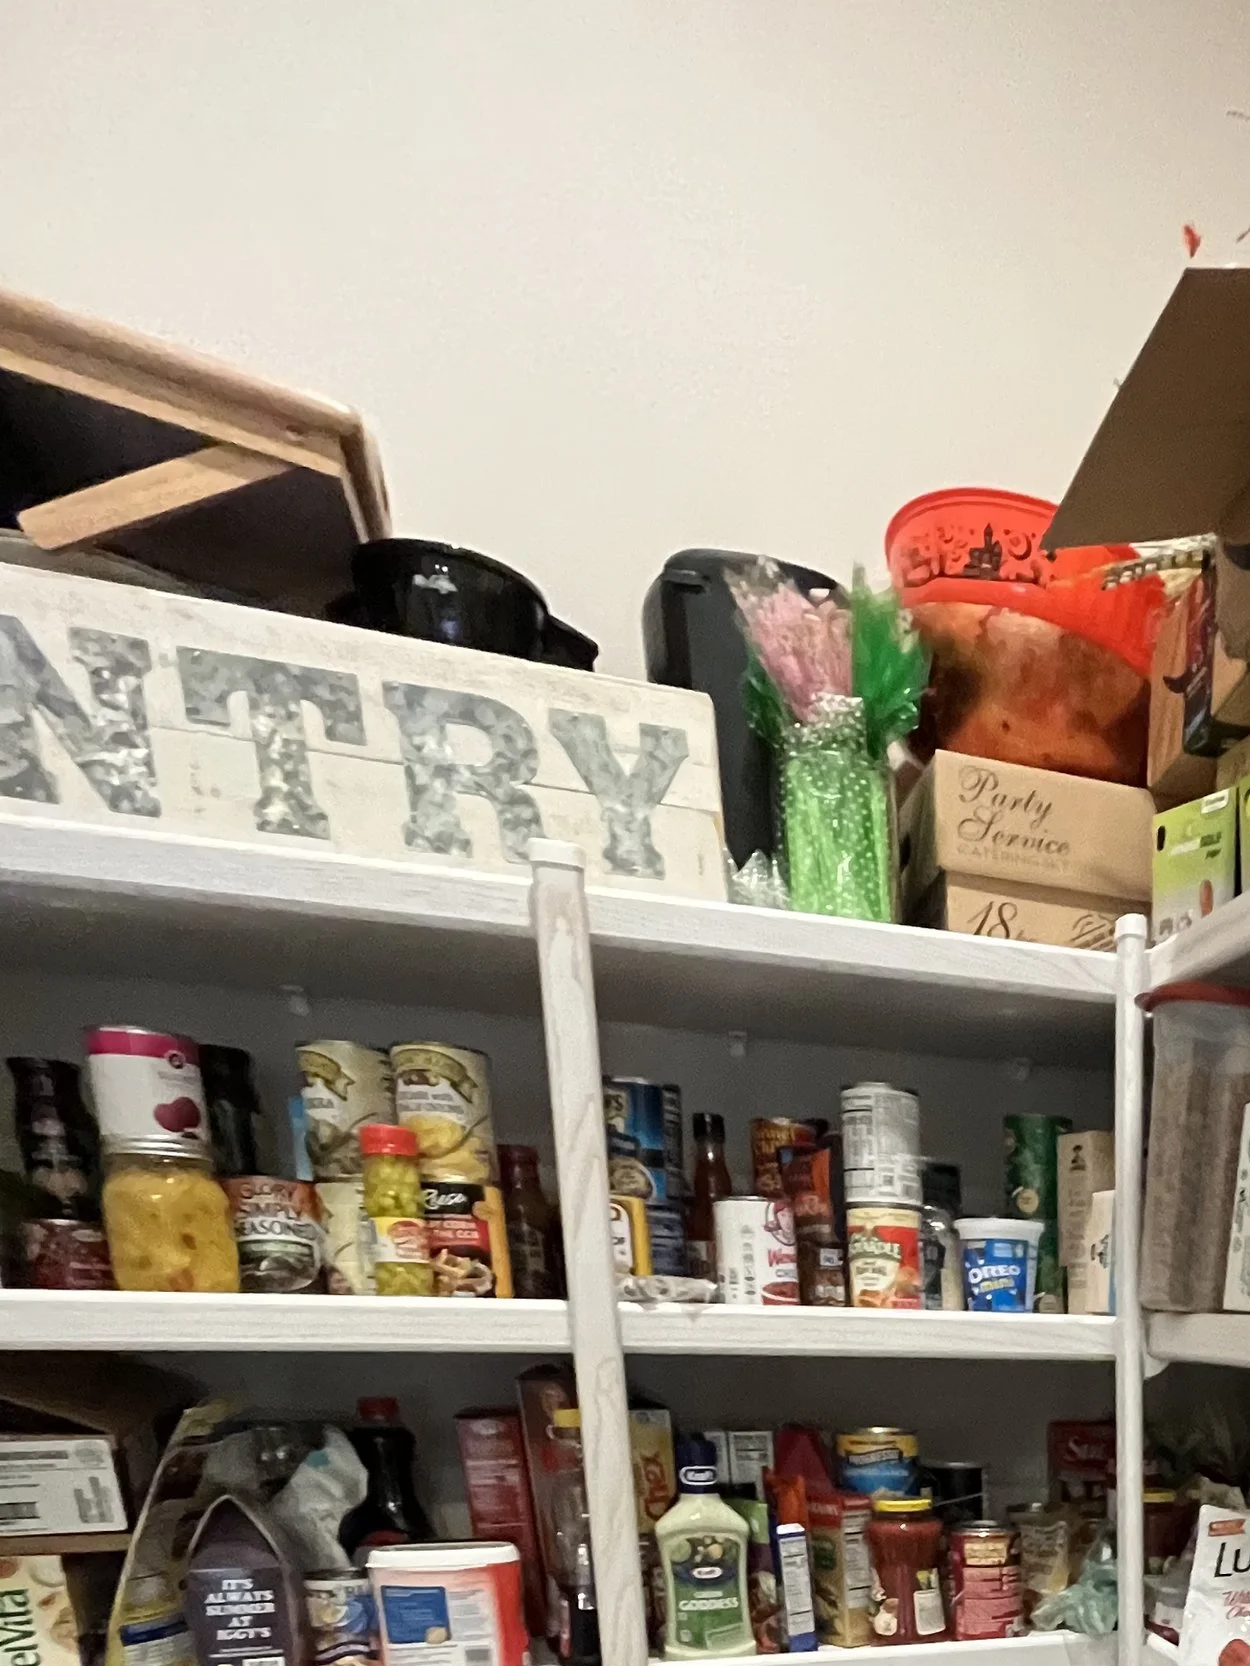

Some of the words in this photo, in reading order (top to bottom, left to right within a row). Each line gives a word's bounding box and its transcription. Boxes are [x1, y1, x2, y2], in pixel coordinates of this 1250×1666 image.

[957, 764, 1053, 830] Party
[956, 804, 1072, 856] Service
[968, 1264, 1021, 1284] OREO
[203, 1589, 275, 1604] ALWAYS
[678, 1597, 740, 1611] GODDESS
